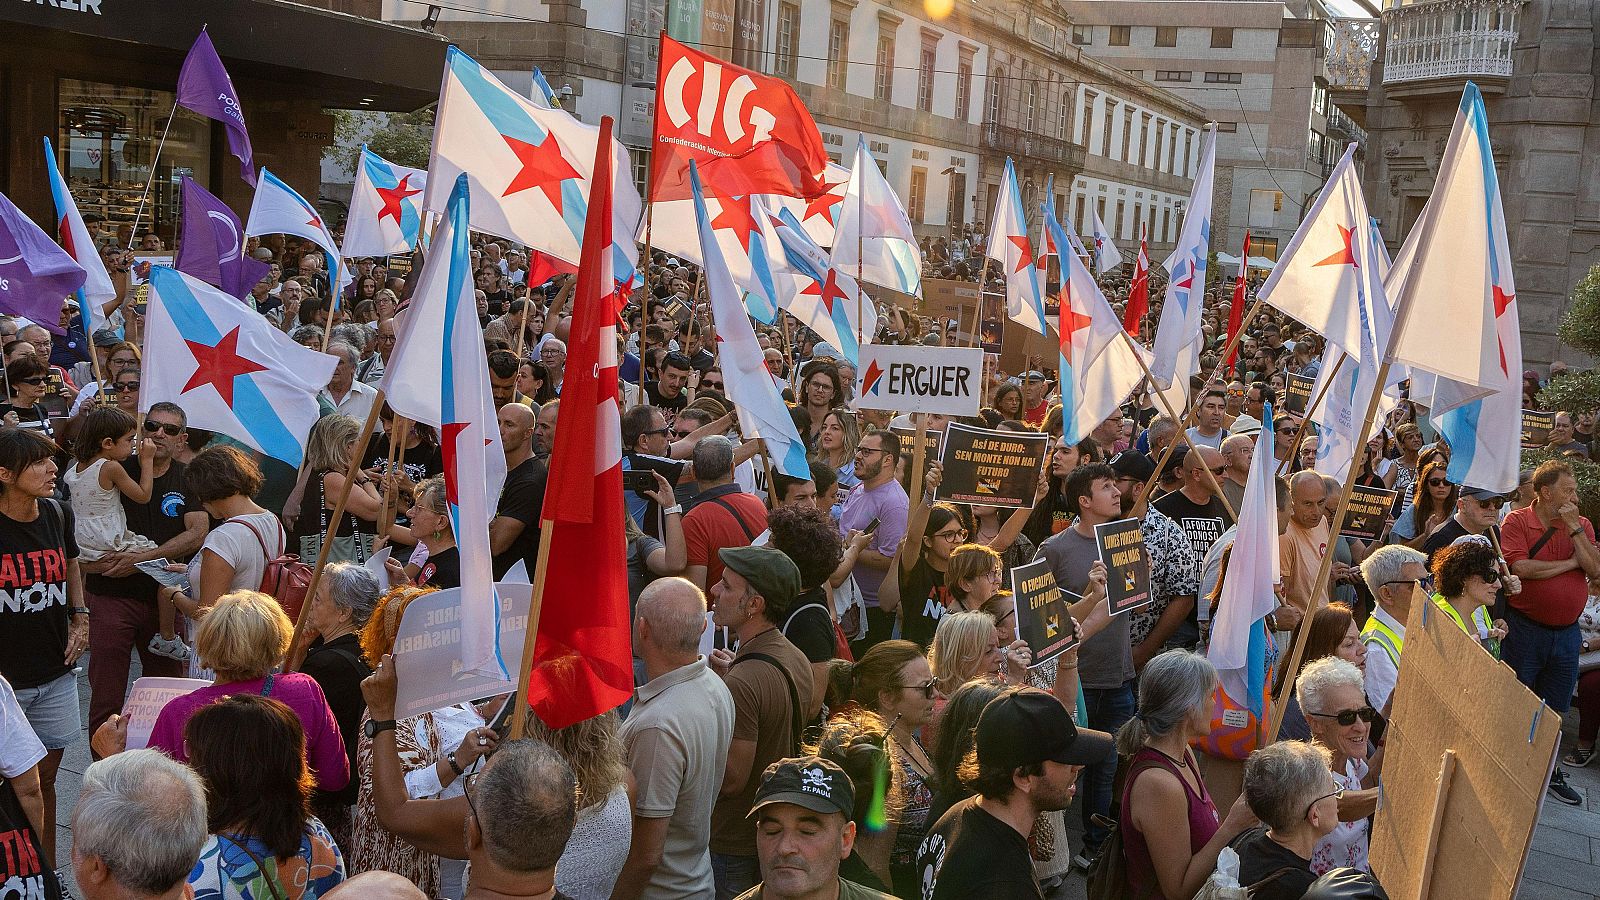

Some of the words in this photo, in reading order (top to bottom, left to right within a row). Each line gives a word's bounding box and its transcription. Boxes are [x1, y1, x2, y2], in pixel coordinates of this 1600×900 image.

[712, 21, 726, 32] 2025
[218, 92, 240, 110] POD
[663, 55, 777, 145] CIG
[224, 106, 245, 126] Gali
[889, 363, 971, 397] ERGUER
[96, 394, 109, 402] CN
[901, 435, 937, 448] FORAIS
[987, 441, 1000, 451] DE
[999, 442, 1026, 454] DURO:
[954, 450, 973, 462] SEN
[972, 452, 1003, 465] MONTE
[1002, 455, 1021, 466] NON
[1020, 457, 1036, 467] HAI
[976, 465, 1010, 478] FUTURO
[1191, 541, 1210, 552] MOR
[0, 546, 67, 588] ALTRI
[812, 787, 831, 799] PAULI
